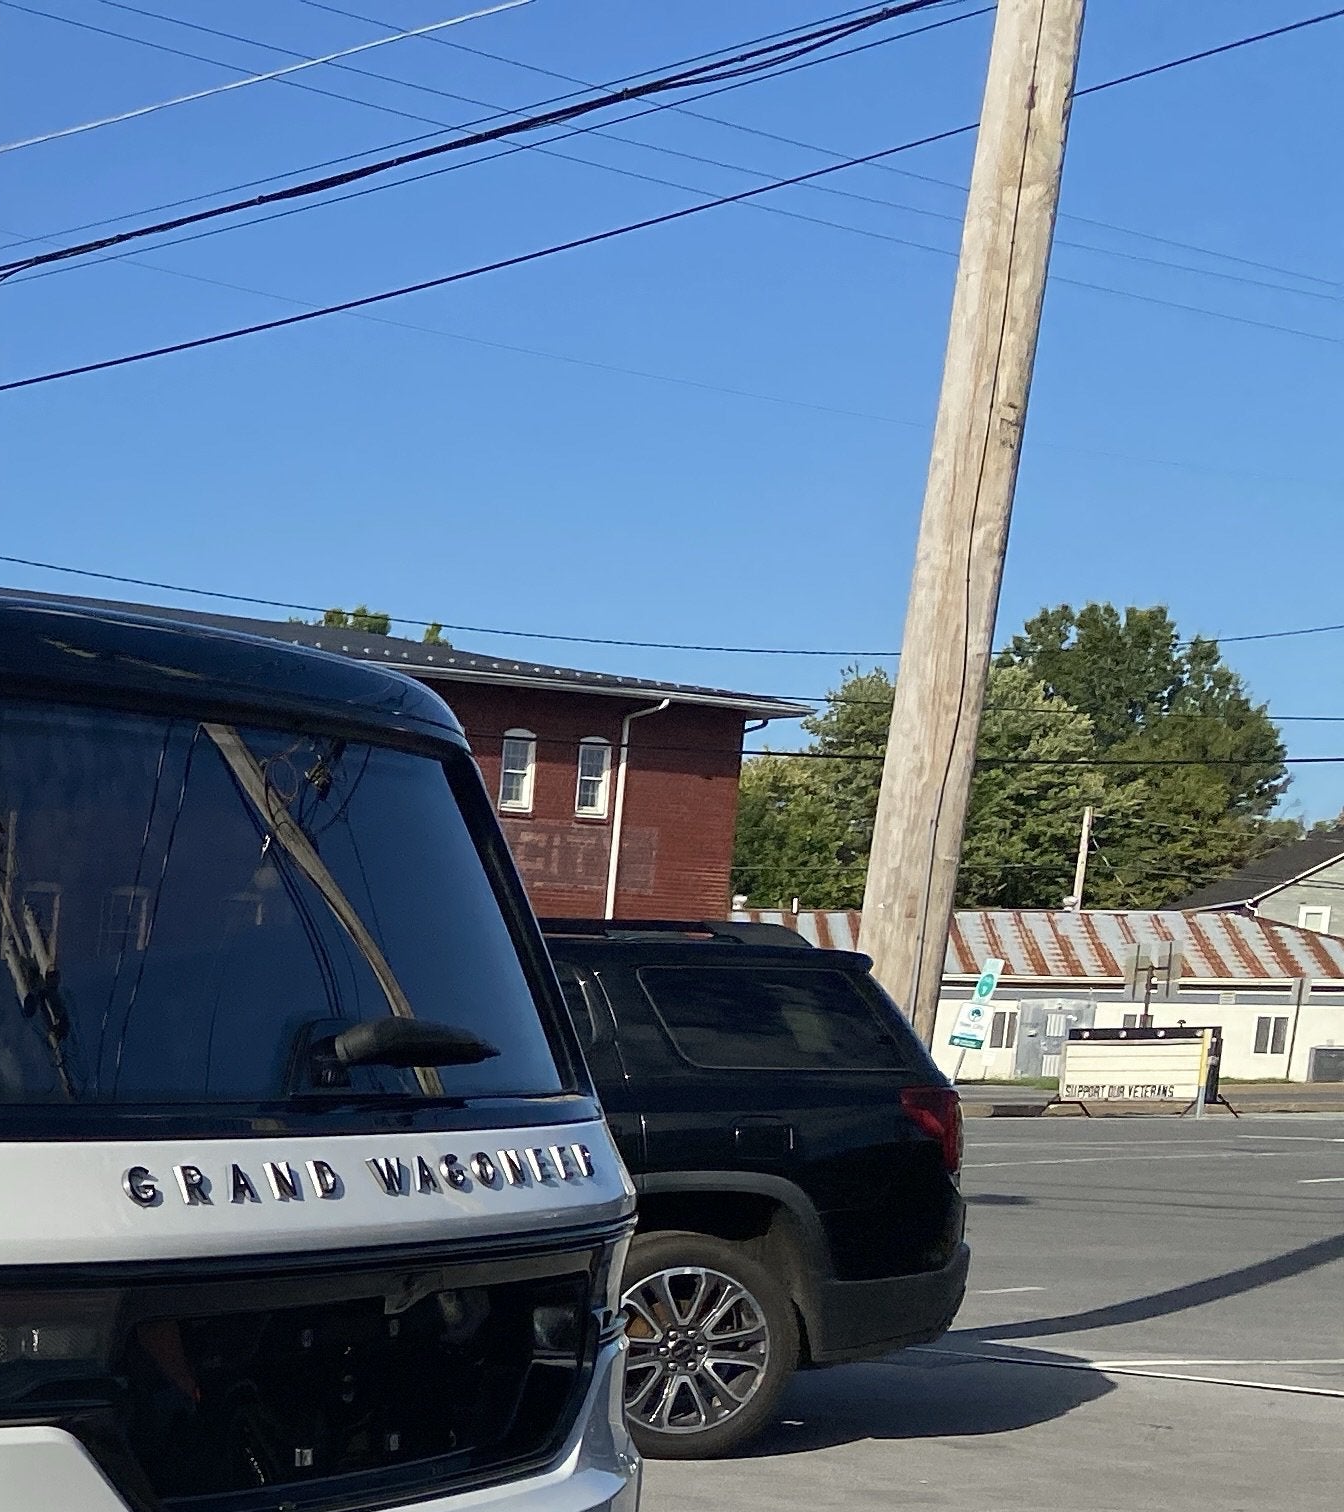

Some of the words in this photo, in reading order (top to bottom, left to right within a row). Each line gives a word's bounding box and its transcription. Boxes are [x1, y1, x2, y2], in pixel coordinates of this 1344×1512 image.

[1065, 1084, 1106, 1098] SUPPORT
[1108, 1084, 1125, 1098] OUR
[1128, 1084, 1175, 1098] VETERANS
[121, 1160, 345, 1209] GRAND
[364, 1142, 596, 1198] WAGONEER
